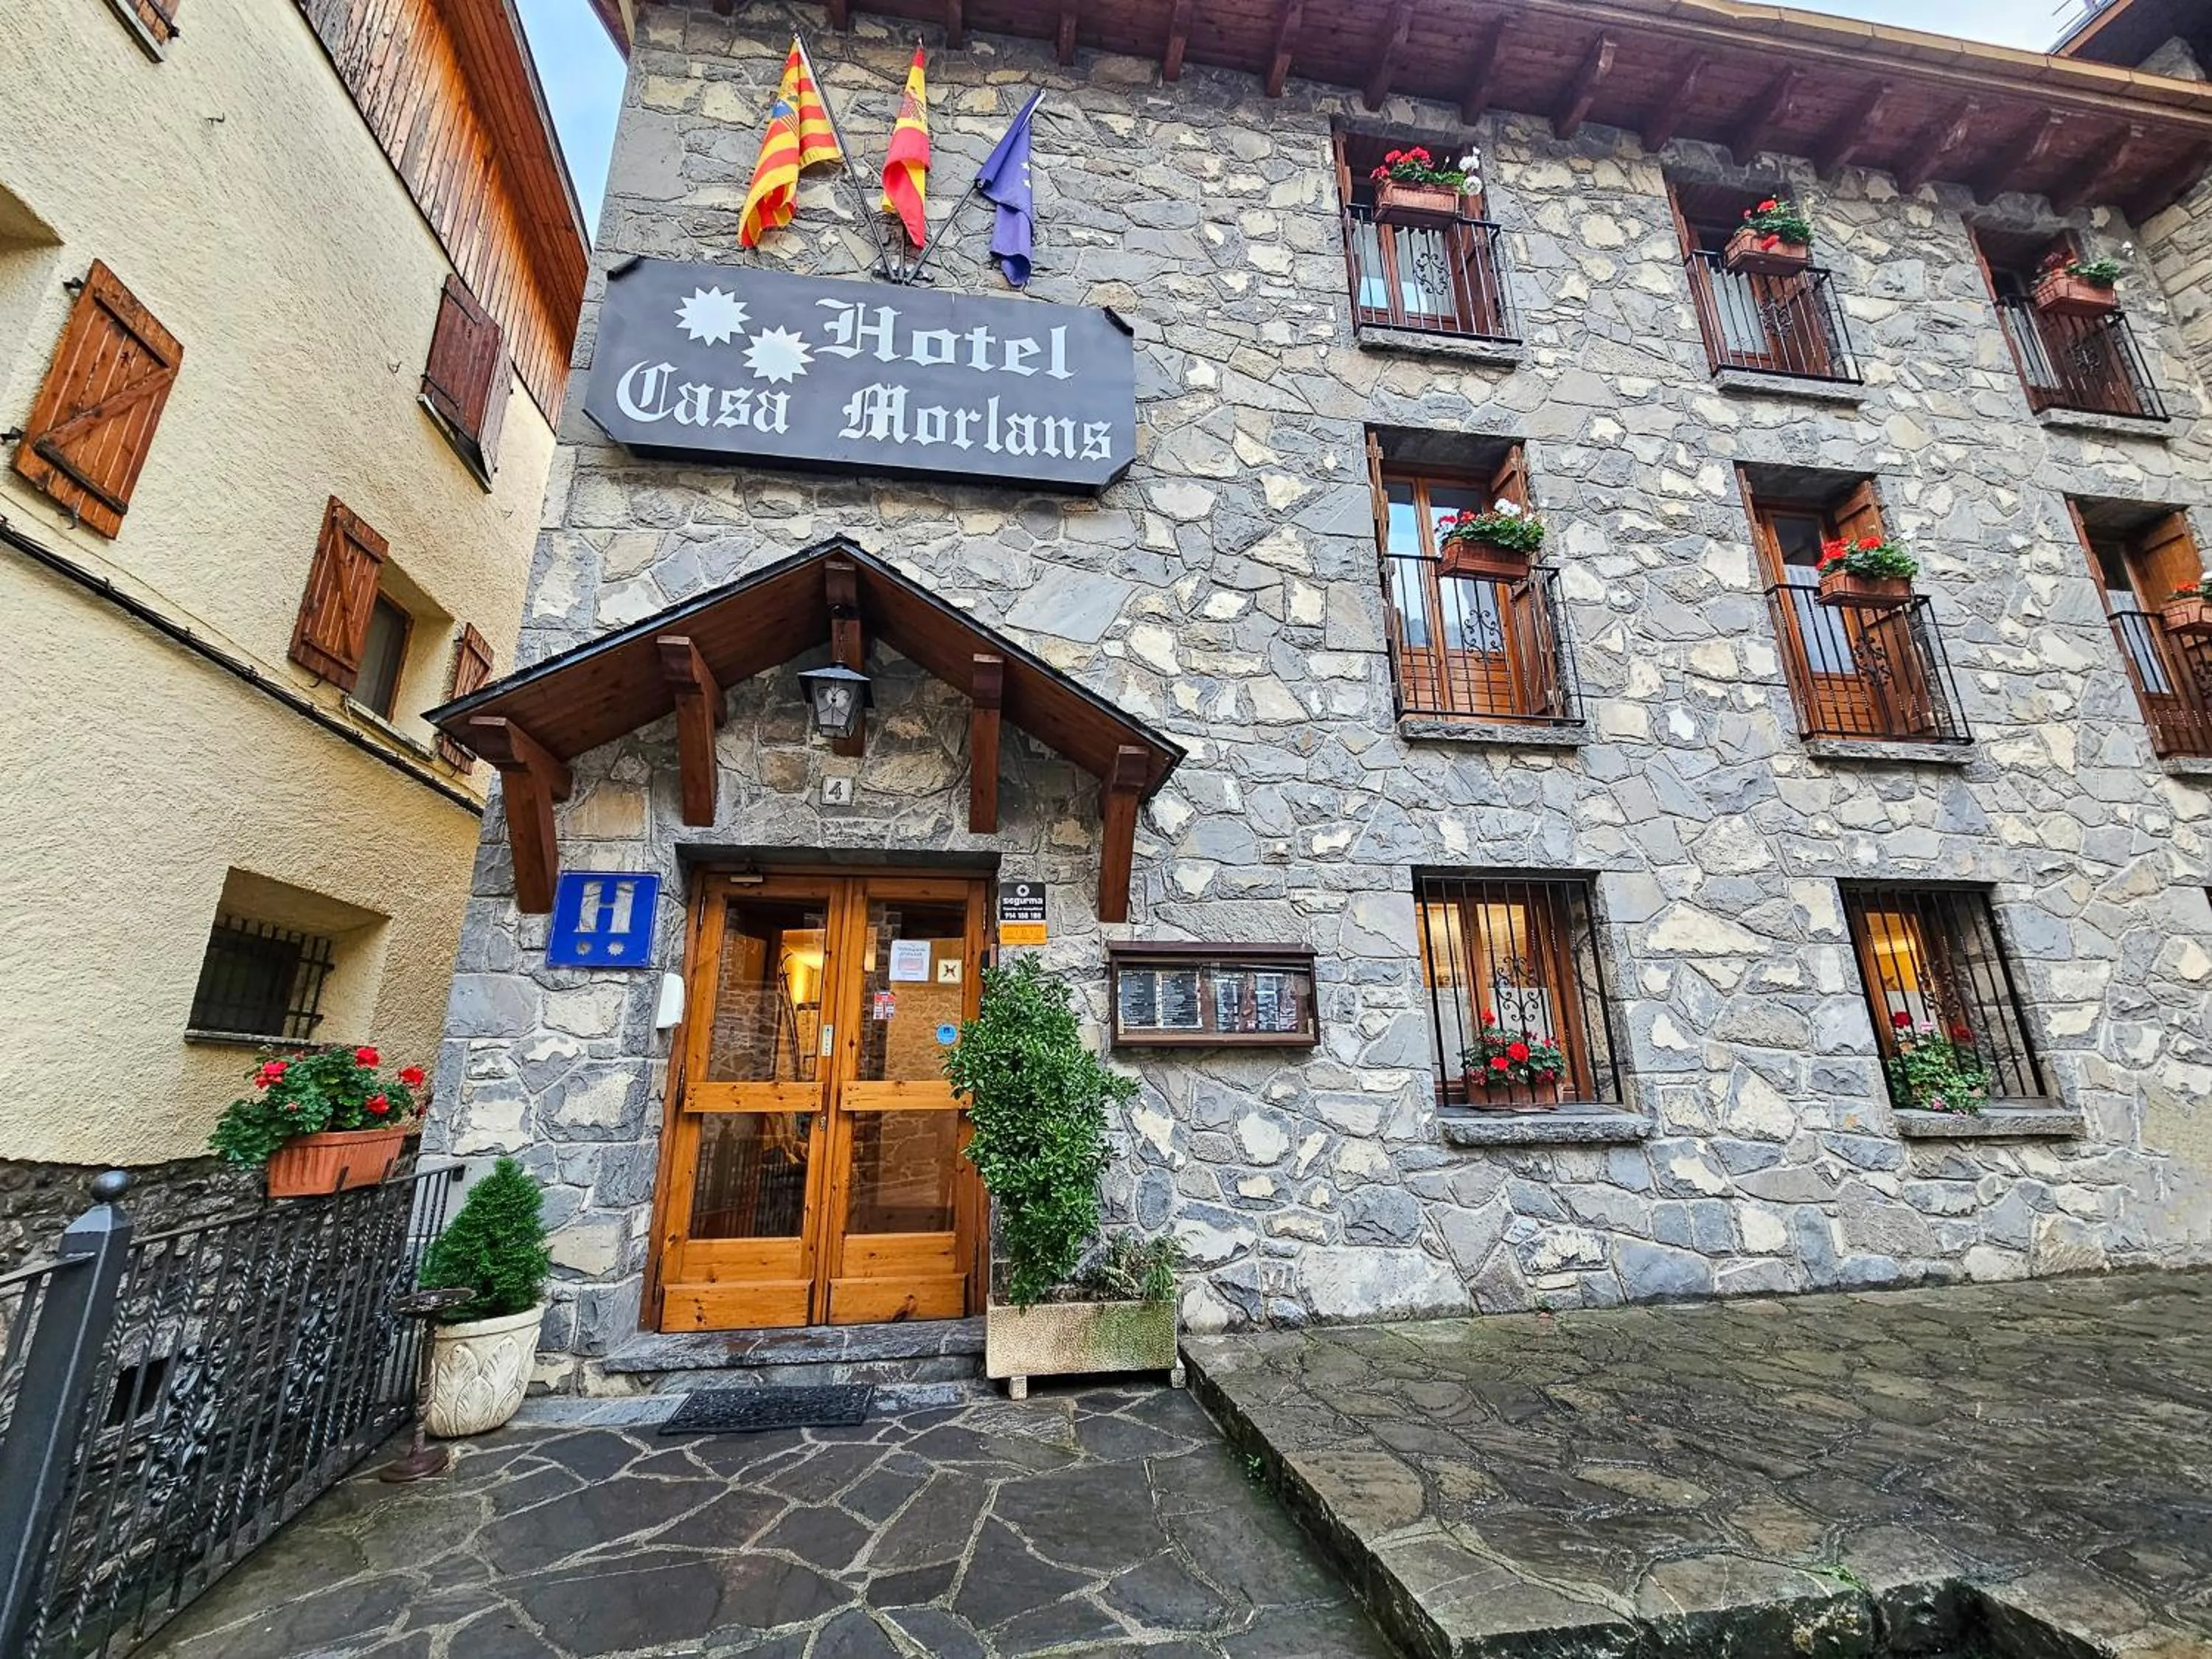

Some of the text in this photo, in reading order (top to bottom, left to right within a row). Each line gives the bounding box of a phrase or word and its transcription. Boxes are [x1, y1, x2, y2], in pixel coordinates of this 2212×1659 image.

[814, 298, 1076, 380] Hotel
[616, 360, 1113, 461] Casa Morlans
[828, 781, 843, 801] 4
[574, 881, 639, 933] H
